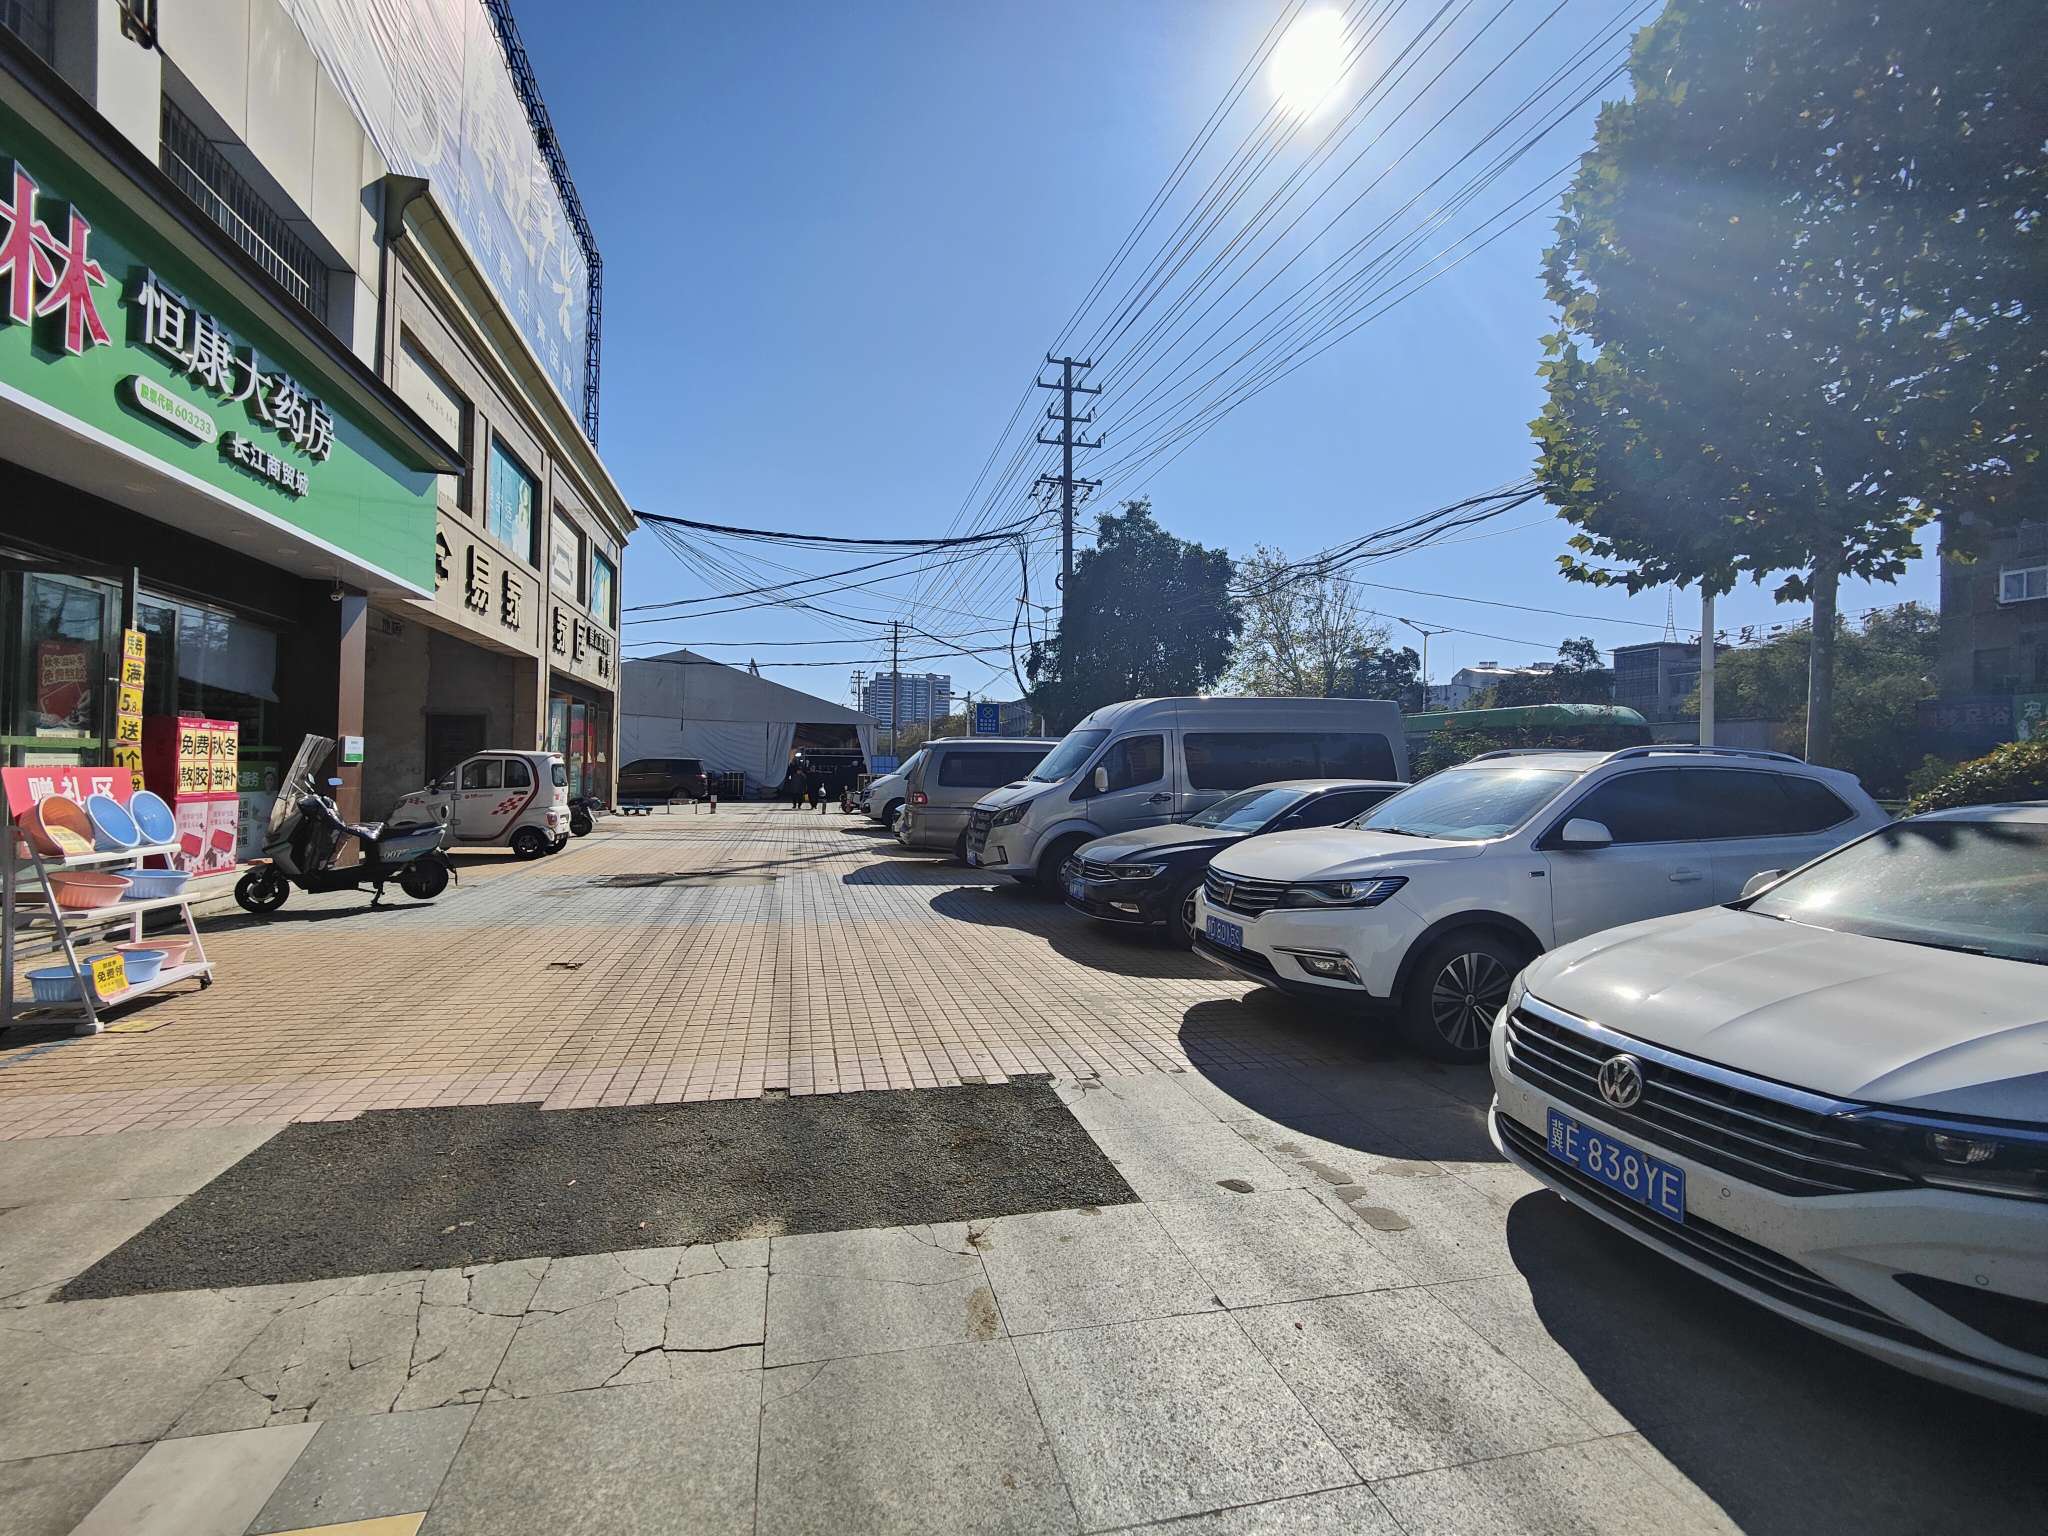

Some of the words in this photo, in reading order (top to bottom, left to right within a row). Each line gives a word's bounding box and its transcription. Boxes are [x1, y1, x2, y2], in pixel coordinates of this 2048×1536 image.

[0, 162, 112, 357] 林
[138, 272, 336, 462] 恒康大药房
[232, 432, 309, 497] 长江商贸城
[181, 735, 237, 756] 免费秋冬
[28, 776, 118, 805] 赠礼区
[180, 766, 236, 787] 熬胶滋补
